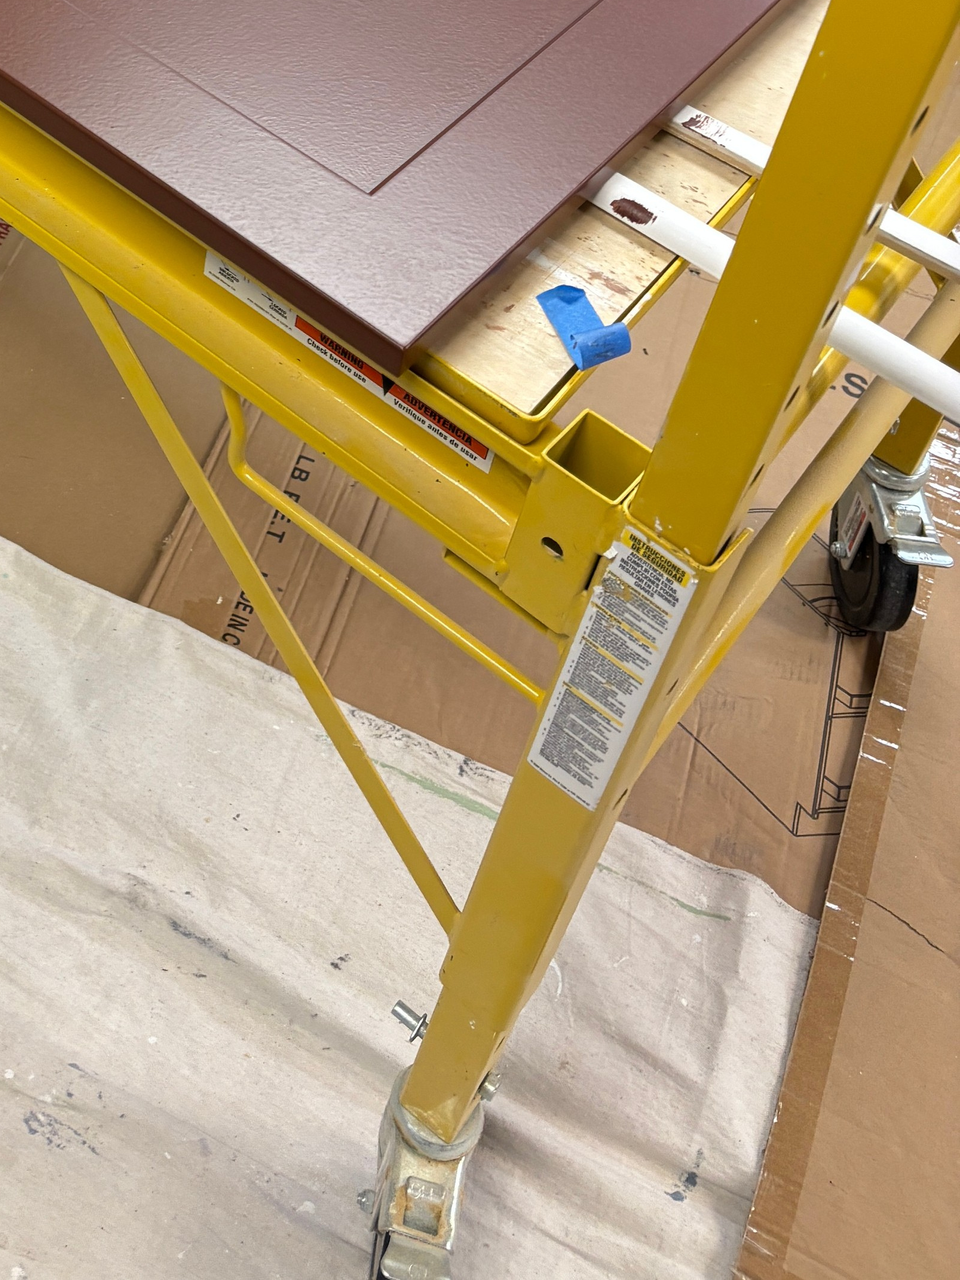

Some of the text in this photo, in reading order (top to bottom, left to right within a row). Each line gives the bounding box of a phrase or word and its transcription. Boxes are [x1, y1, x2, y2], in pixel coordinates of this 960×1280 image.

[306, 337, 367, 384] Check before use
[320, 333, 364, 370] WARNING
[393, 398, 478, 461] Verifique antes de usar
[403, 392, 473, 447] ADVERTENCIA
[629, 533, 687, 578] INSTRUCCIONES
[630, 543, 641, 554] DE
[642, 549, 684, 584] SEGURIDAD
